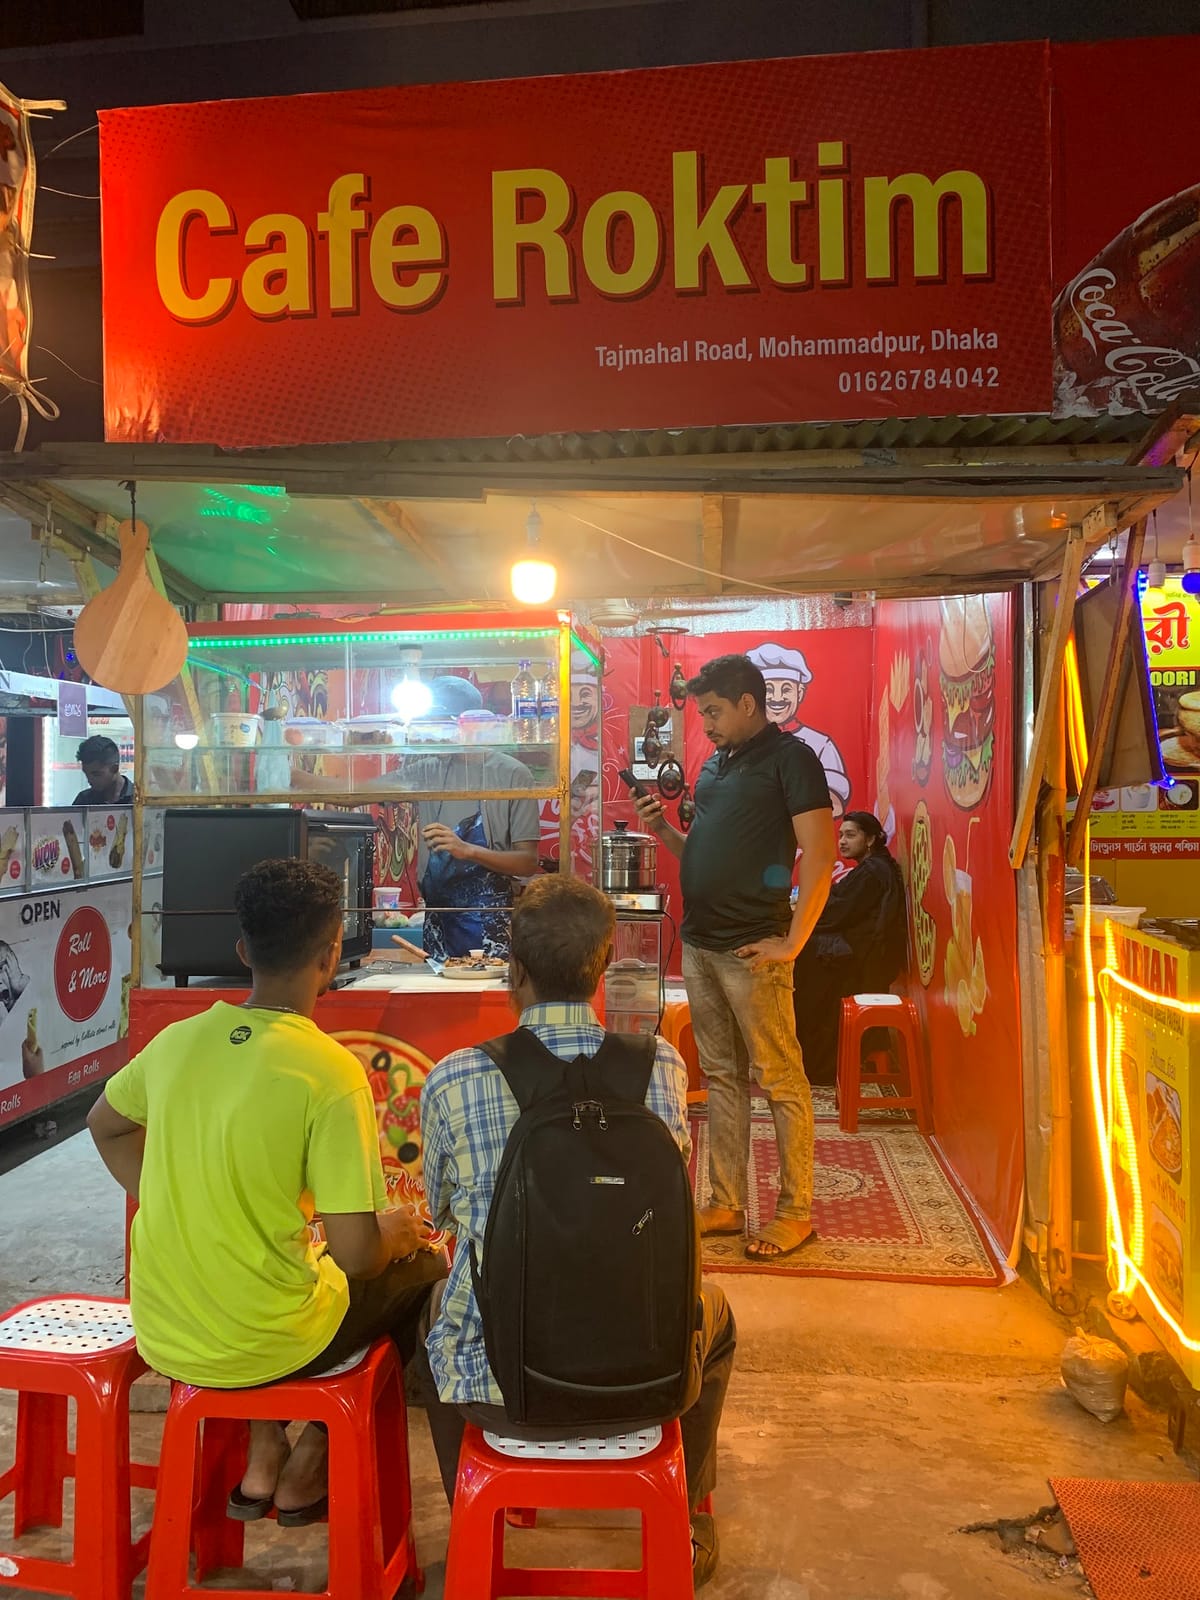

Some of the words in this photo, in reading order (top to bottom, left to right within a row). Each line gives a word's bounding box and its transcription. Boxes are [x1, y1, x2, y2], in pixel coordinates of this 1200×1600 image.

[155, 173, 447, 324] Cafe
[492, 140, 993, 303] Roktim
[1070, 267, 1200, 402] Coca-Col
[595, 341, 689, 370] Tajmahal
[695, 336, 753, 362] Road,
[759, 331, 926, 359] Mohammadpur,
[931, 327, 999, 351] Dhaka
[838, 366, 1000, 393] 01626784042
[1150, 671, 1196, 686] OORI
[21, 900, 60, 925] OPEN
[68, 932, 92, 957] Roll
[68, 970, 77, 993] &
[79, 967, 108, 990] More
[83, 1059, 100, 1077] Rolls
[0, 1093, 21, 1115] Rolls
